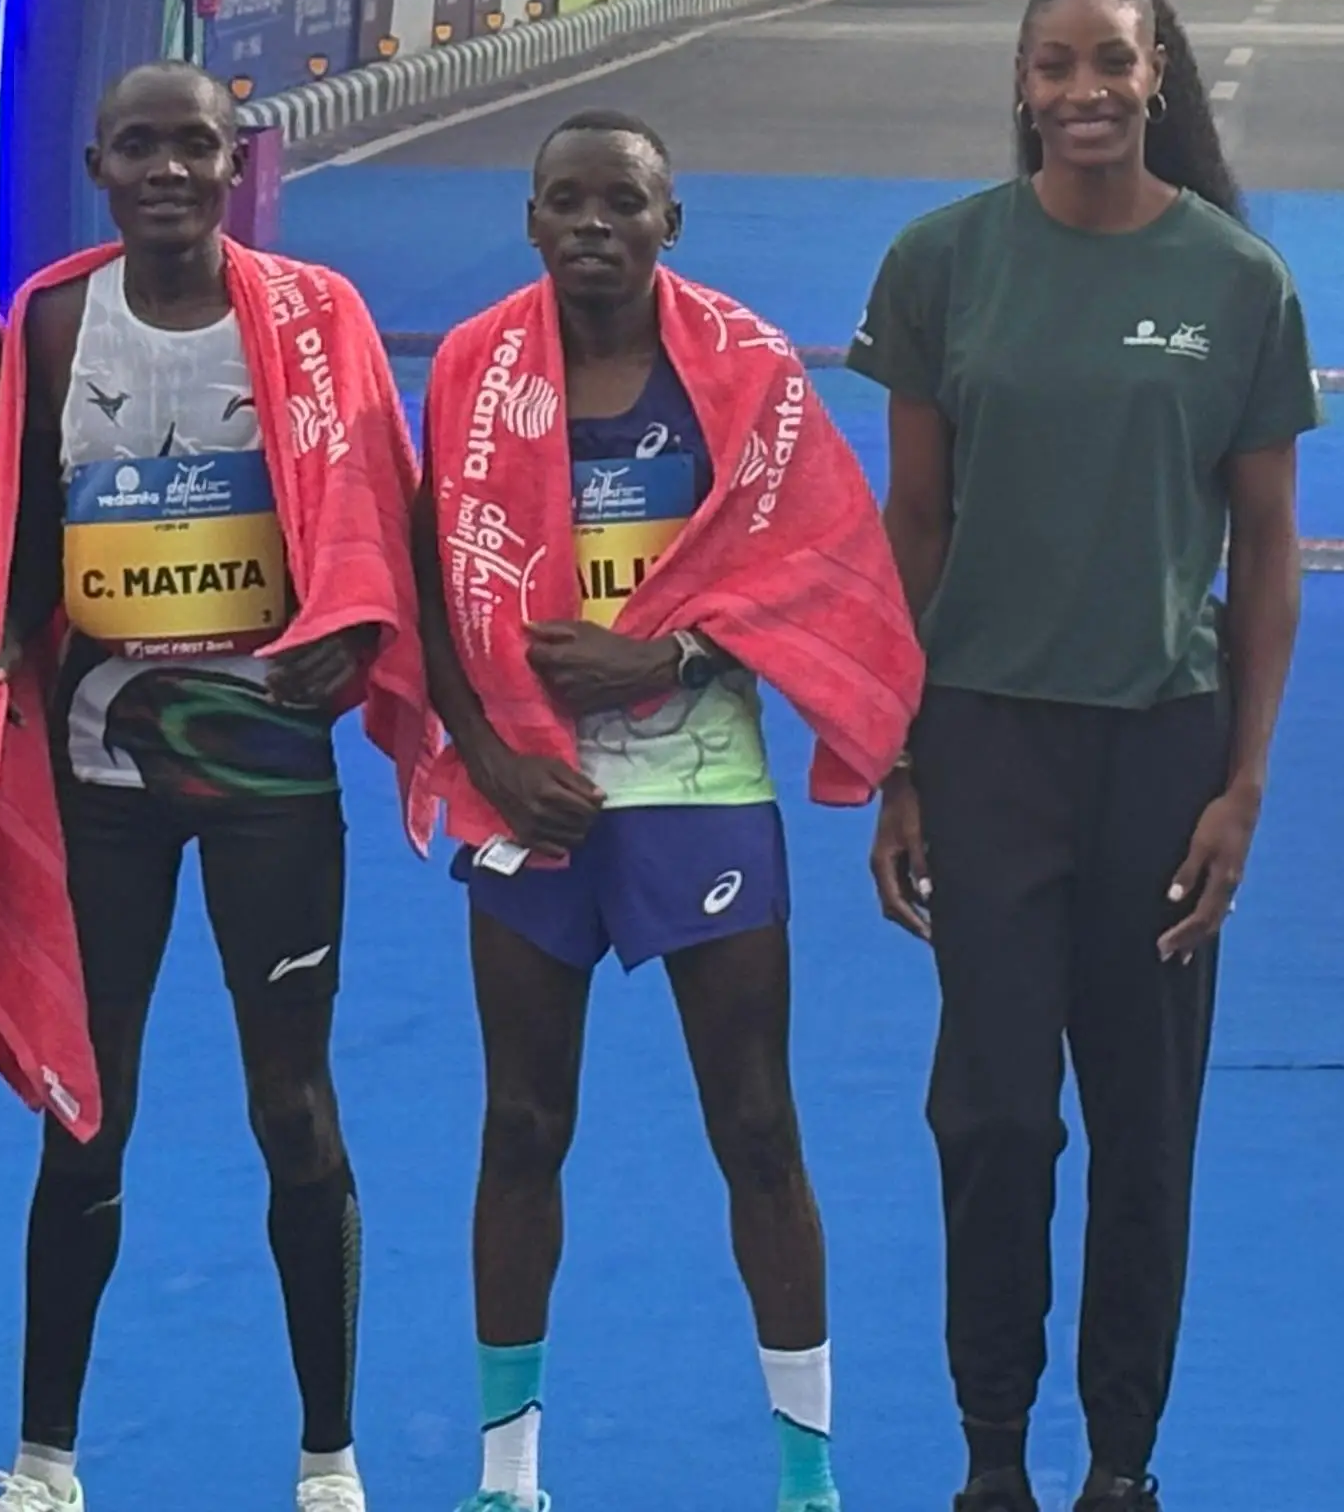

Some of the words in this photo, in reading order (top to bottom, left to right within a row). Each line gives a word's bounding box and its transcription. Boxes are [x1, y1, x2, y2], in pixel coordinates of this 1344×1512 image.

[295, 327, 351, 465] vedanta
[462, 327, 527, 481] vedanta
[748, 376, 805, 534] vedanta
[96, 490, 160, 507] vedanta
[446, 502, 526, 605] delhi
[82, 569, 115, 599] C.
[123, 559, 266, 598] MATATA
